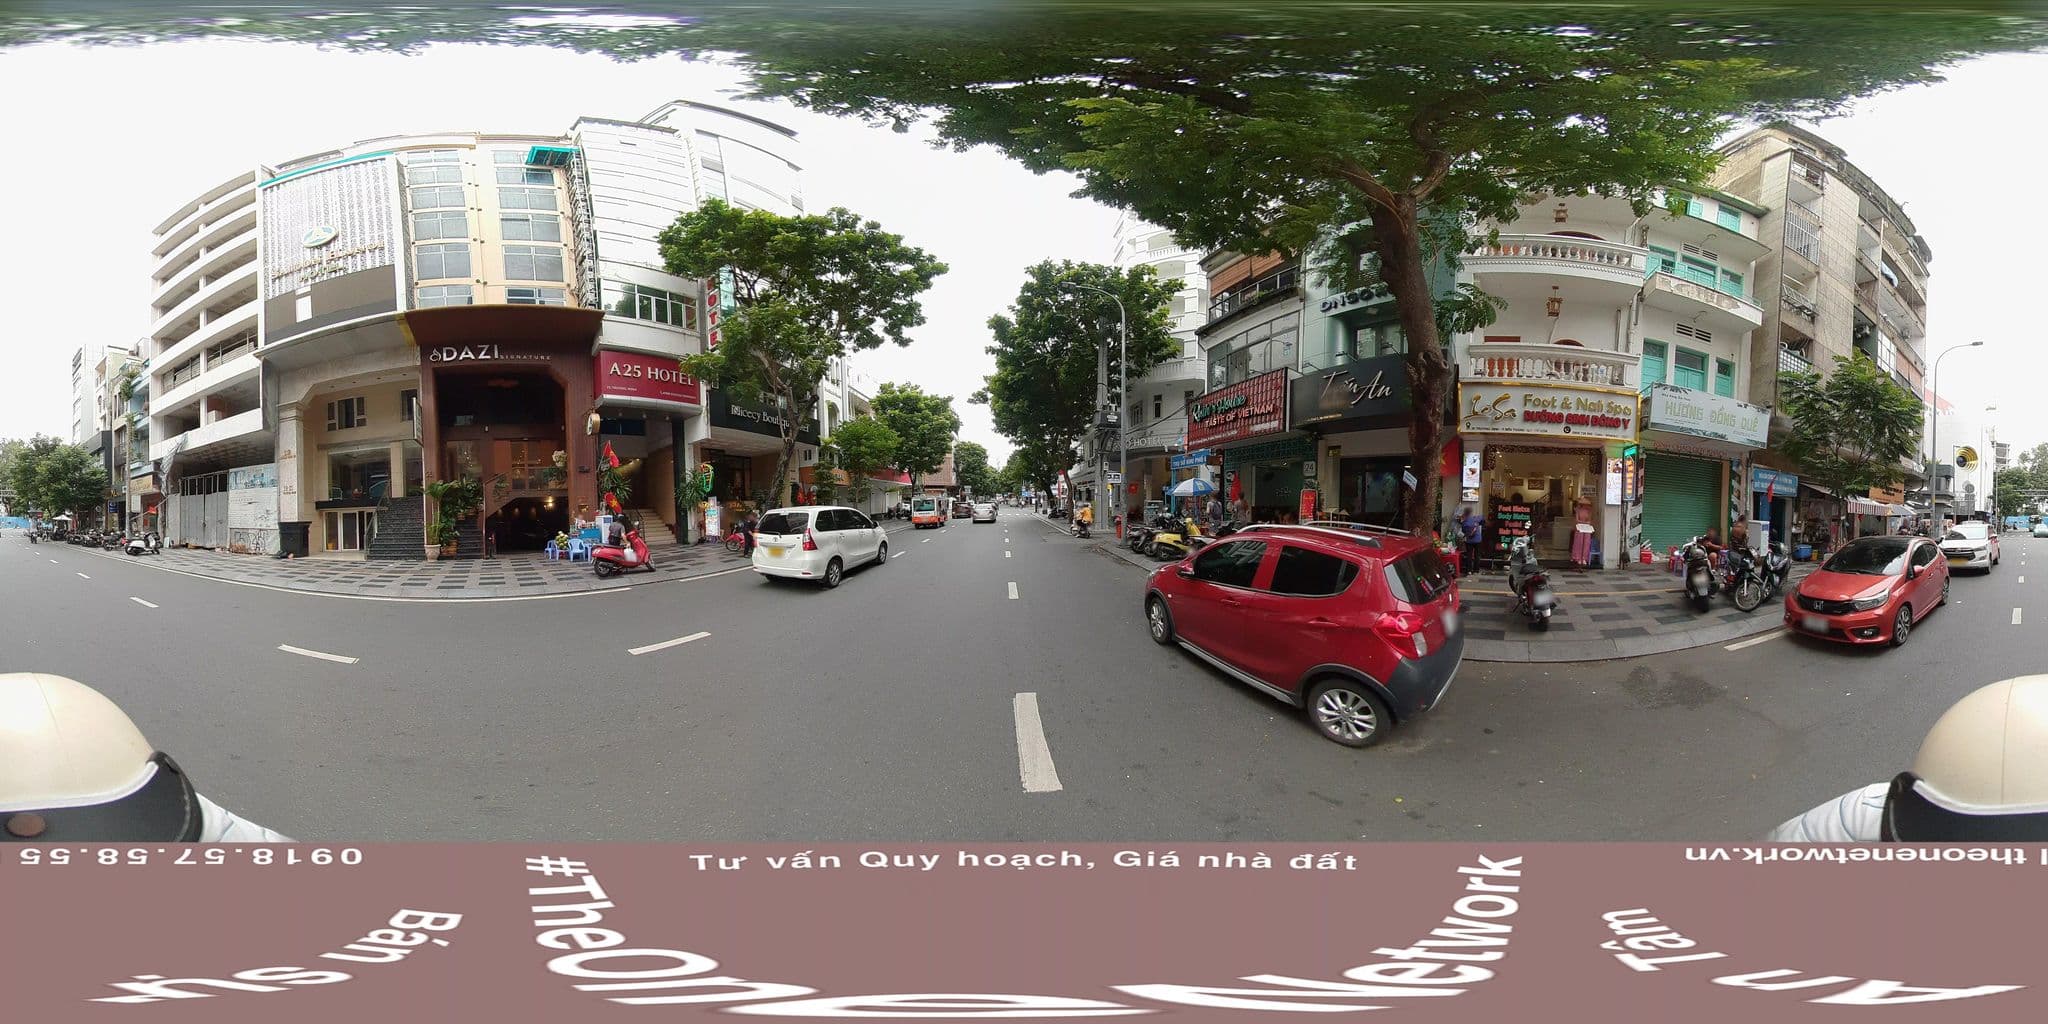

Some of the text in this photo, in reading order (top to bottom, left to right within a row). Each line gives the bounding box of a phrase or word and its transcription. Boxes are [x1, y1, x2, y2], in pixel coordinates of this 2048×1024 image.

[442, 344, 499, 361] DAZI
[609, 362, 694, 386] A25 HOTEL
[1351, 370, 1392, 405] An
[1524, 393, 1557, 409] Foot
[1561, 396, 1572, 410] &
[1576, 397, 1604, 413] Nail
[763, 412, 790, 430] Boutqu
[1205, 403, 1274, 428] TASTE OF VIETNAM
[1565, 413, 1590, 427] SINH
[1622, 418, 1631, 430] Y
